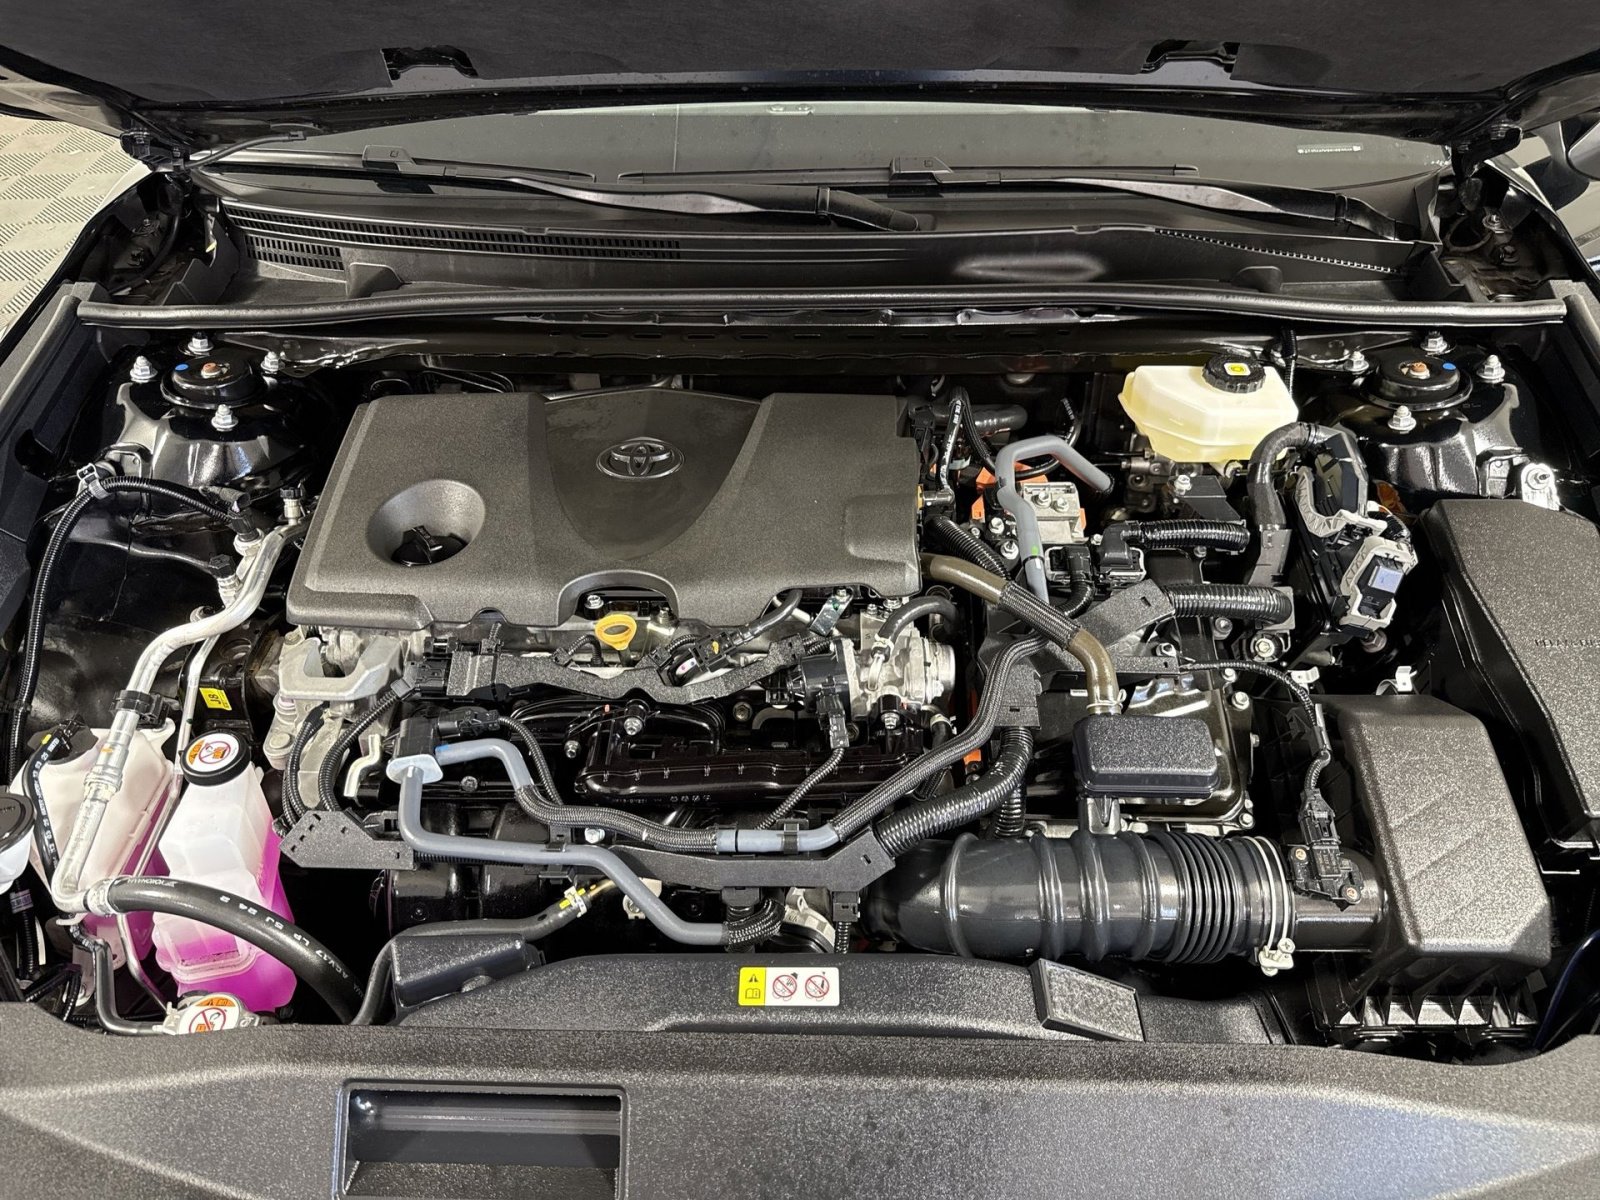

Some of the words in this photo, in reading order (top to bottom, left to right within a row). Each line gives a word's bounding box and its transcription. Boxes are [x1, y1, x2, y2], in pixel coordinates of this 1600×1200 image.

[220, 895, 231, 903] 2
[238, 903, 258, 915] 24
[293, 933, 310, 946] LP
